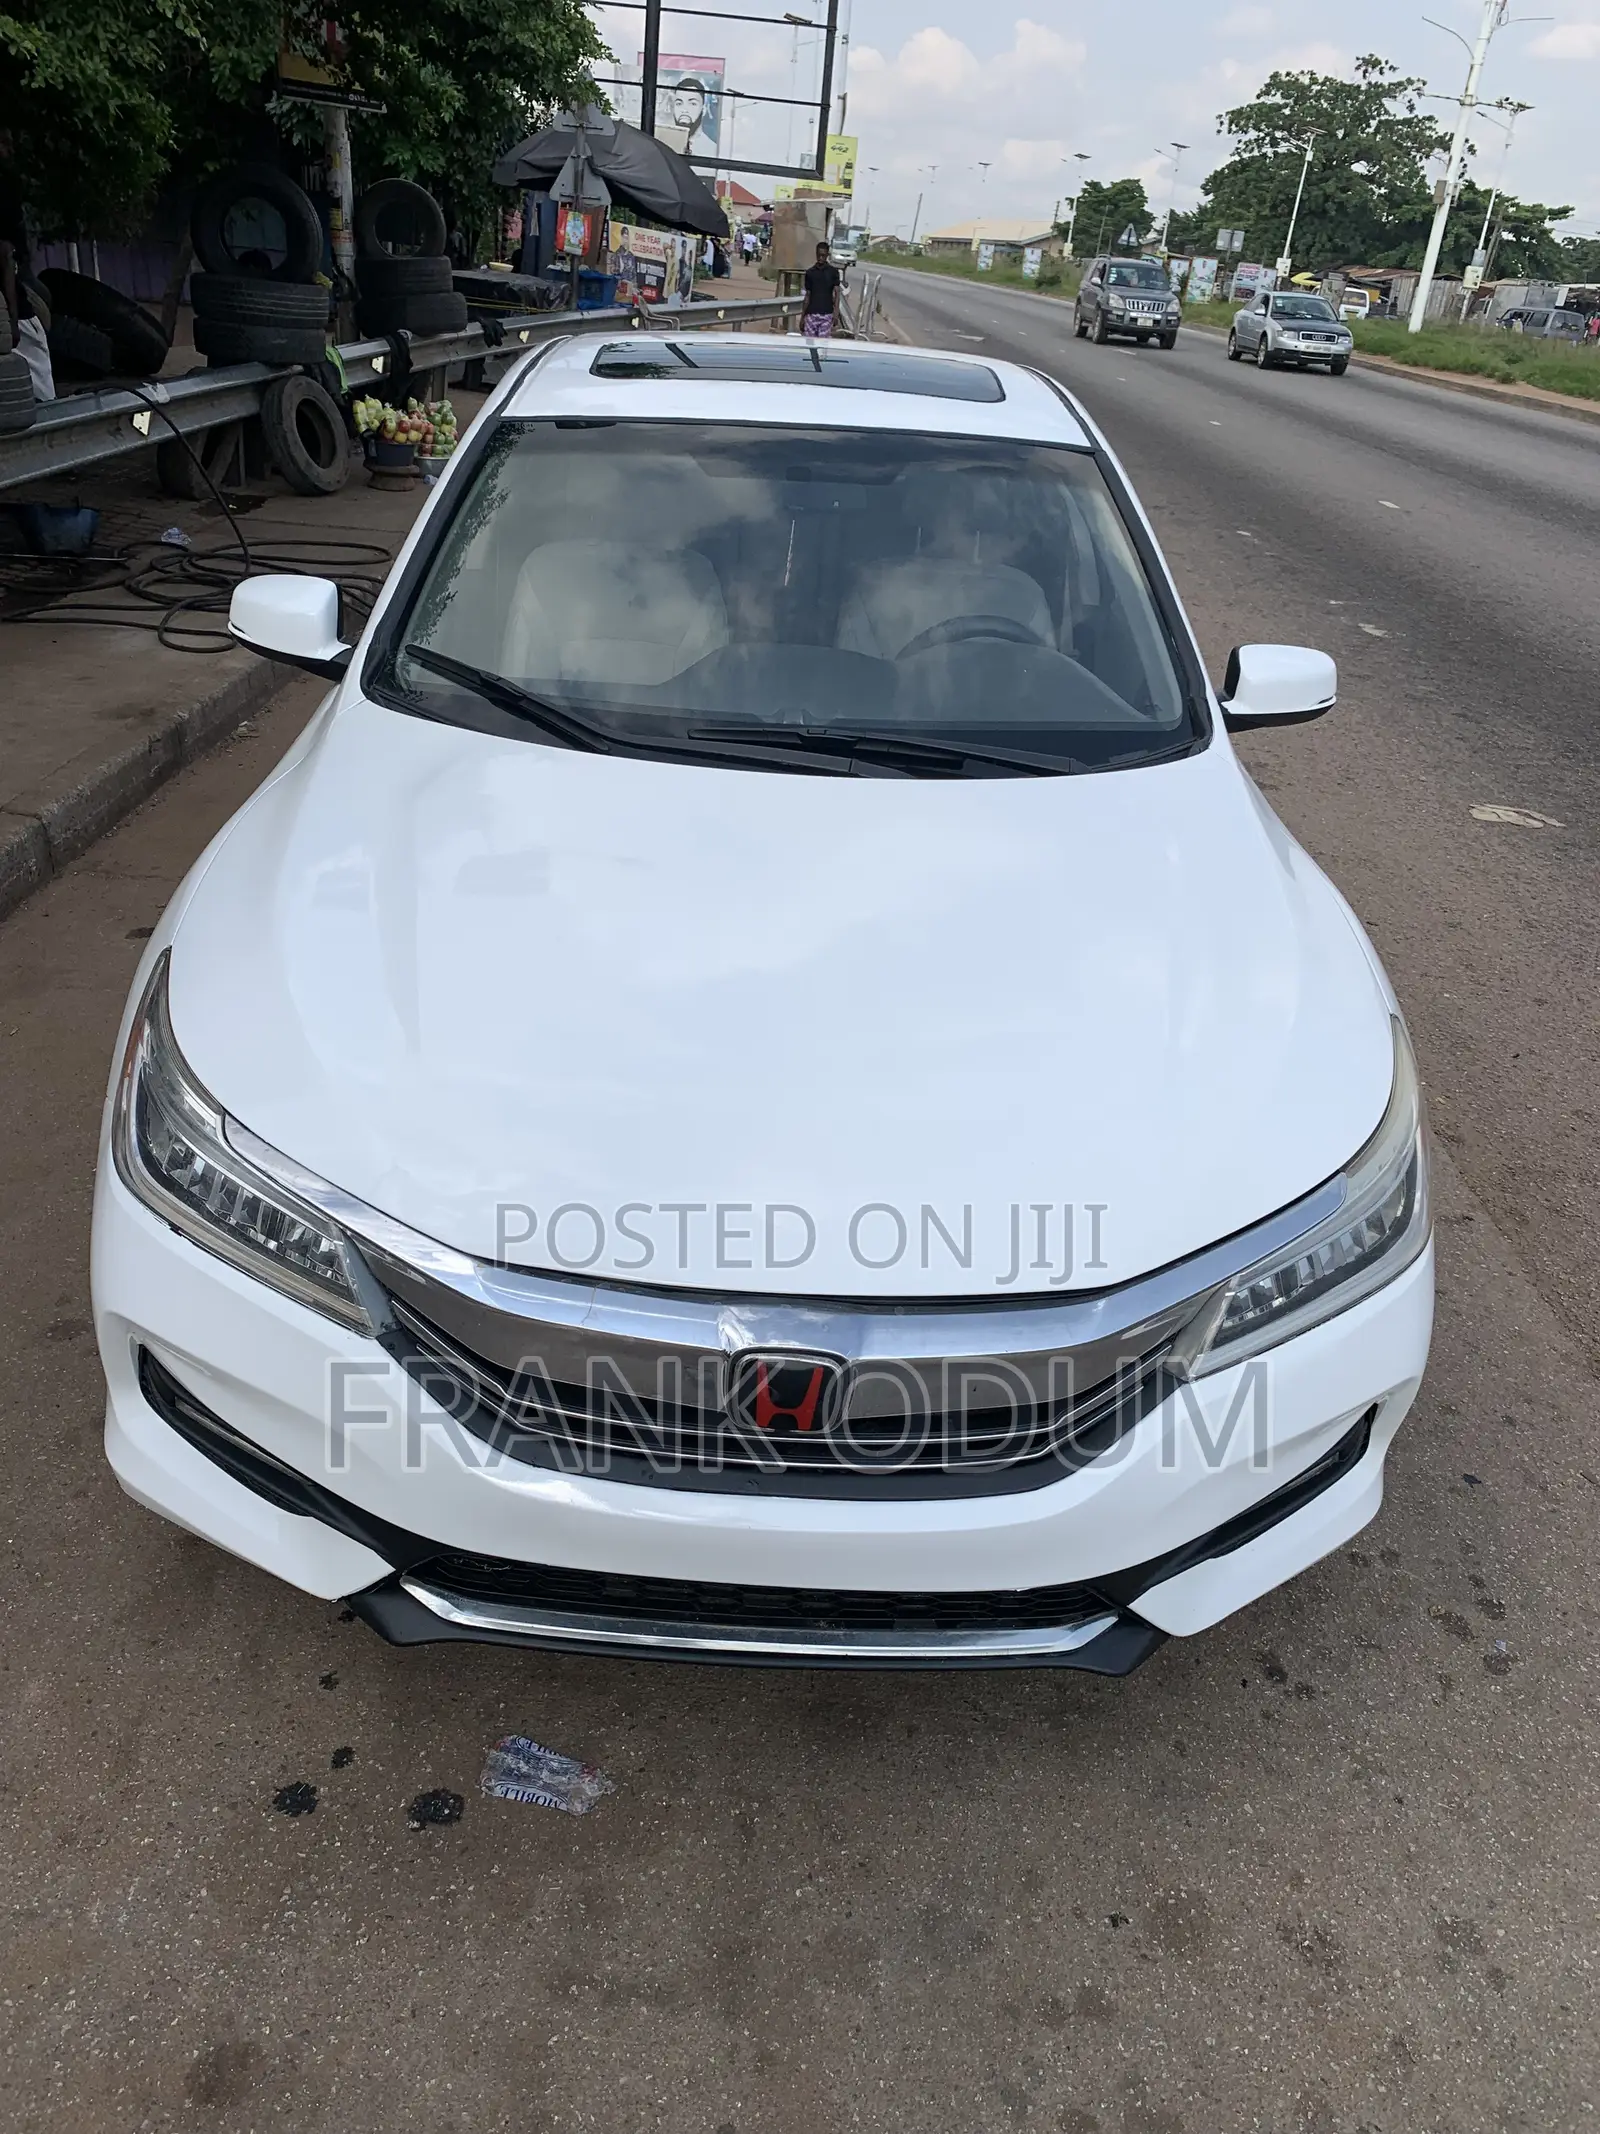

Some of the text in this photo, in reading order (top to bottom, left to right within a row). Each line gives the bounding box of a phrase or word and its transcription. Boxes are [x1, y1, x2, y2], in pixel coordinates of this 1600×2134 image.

[830, 145, 849, 154] 442
[635, 232, 661, 245] ONE YEAR
[632, 243, 663, 257] CELEBRATION
[500, 1785, 562, 1809] MOBILE
